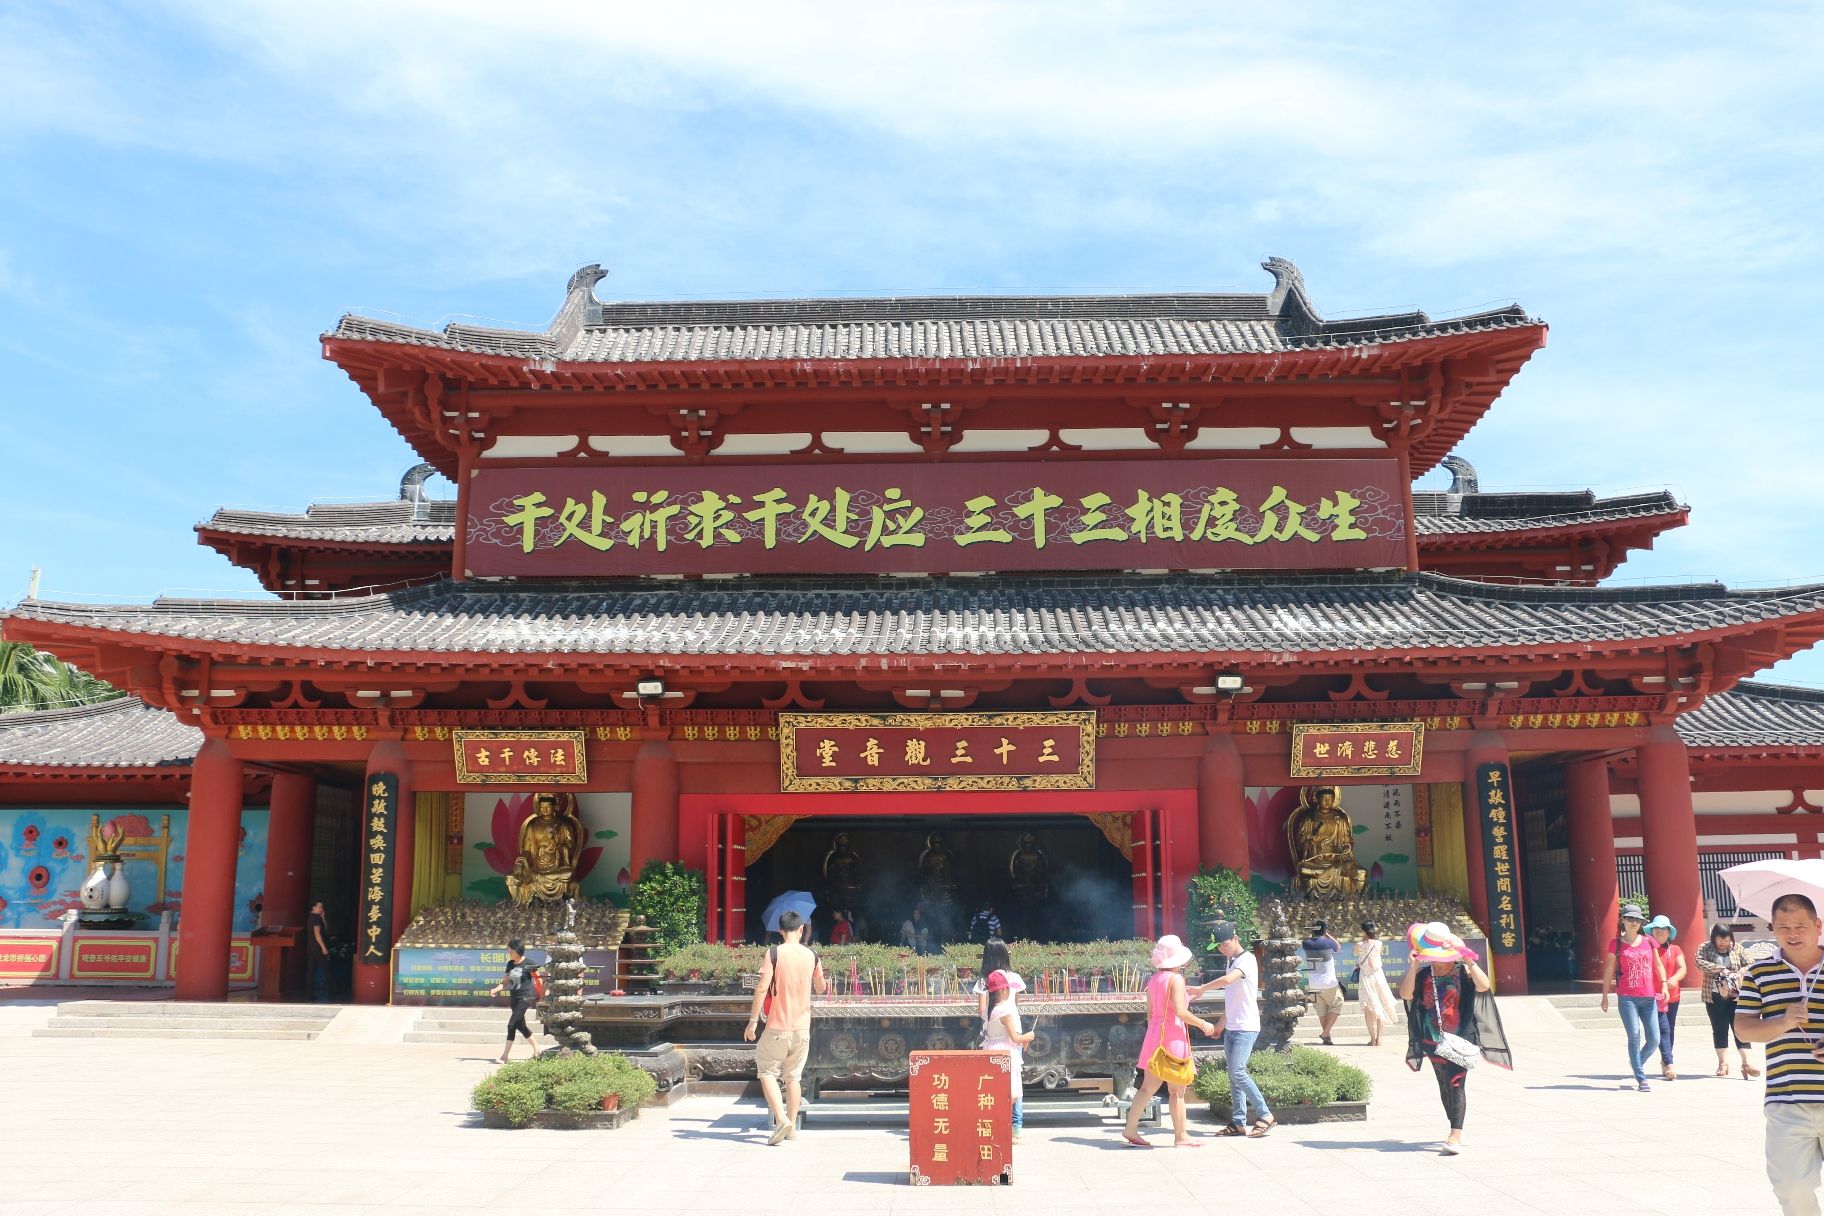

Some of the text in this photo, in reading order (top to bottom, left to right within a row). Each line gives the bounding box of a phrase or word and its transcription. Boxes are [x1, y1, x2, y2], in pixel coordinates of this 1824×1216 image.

[502, 485, 1368, 553] 千处祈求千处应 三十三相度众生
[930, 1073, 950, 1163] 功德无量
[976, 1074, 995, 1161] 广种福田
